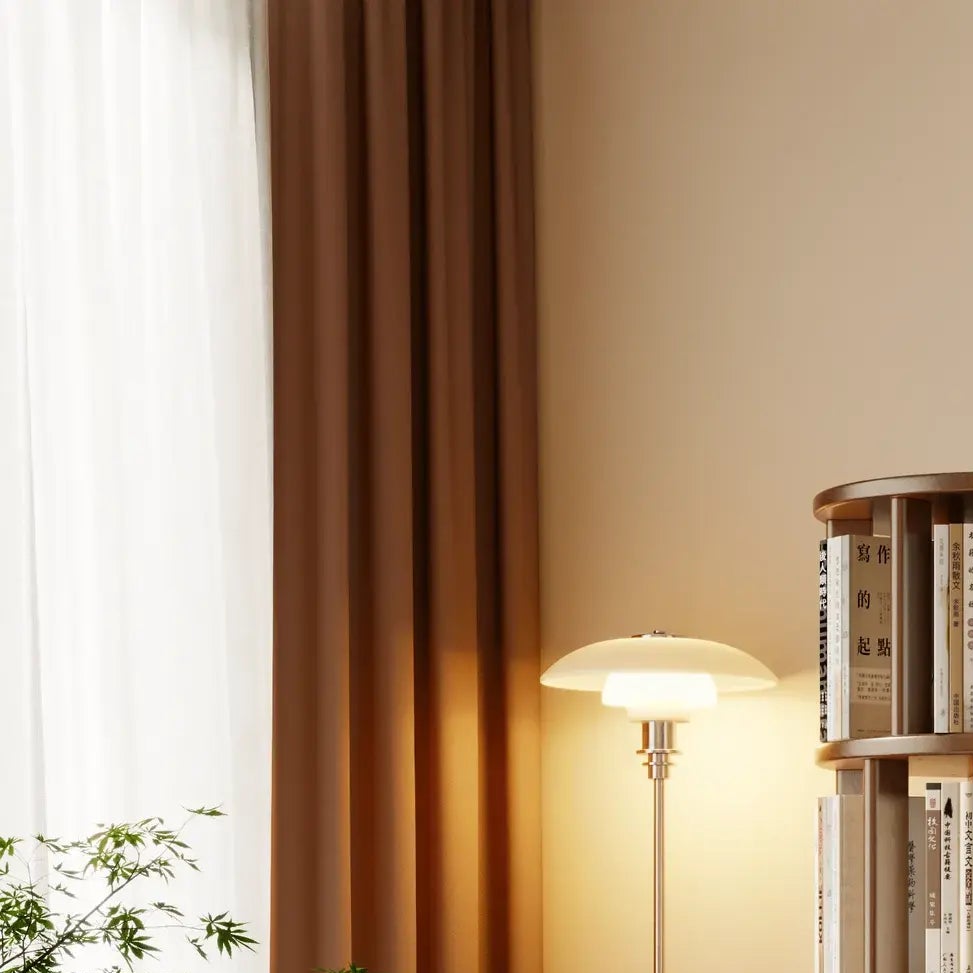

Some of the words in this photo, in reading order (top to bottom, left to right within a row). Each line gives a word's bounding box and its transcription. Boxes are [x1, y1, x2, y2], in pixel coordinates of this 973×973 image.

[952, 542, 961, 590] 余秋雨散文
[857, 590, 871, 610] 的
[857, 637, 890, 657] 起點
[944, 821, 952, 880] 中国科技古籍提要
[964, 811, 973, 867] 初中文言文
